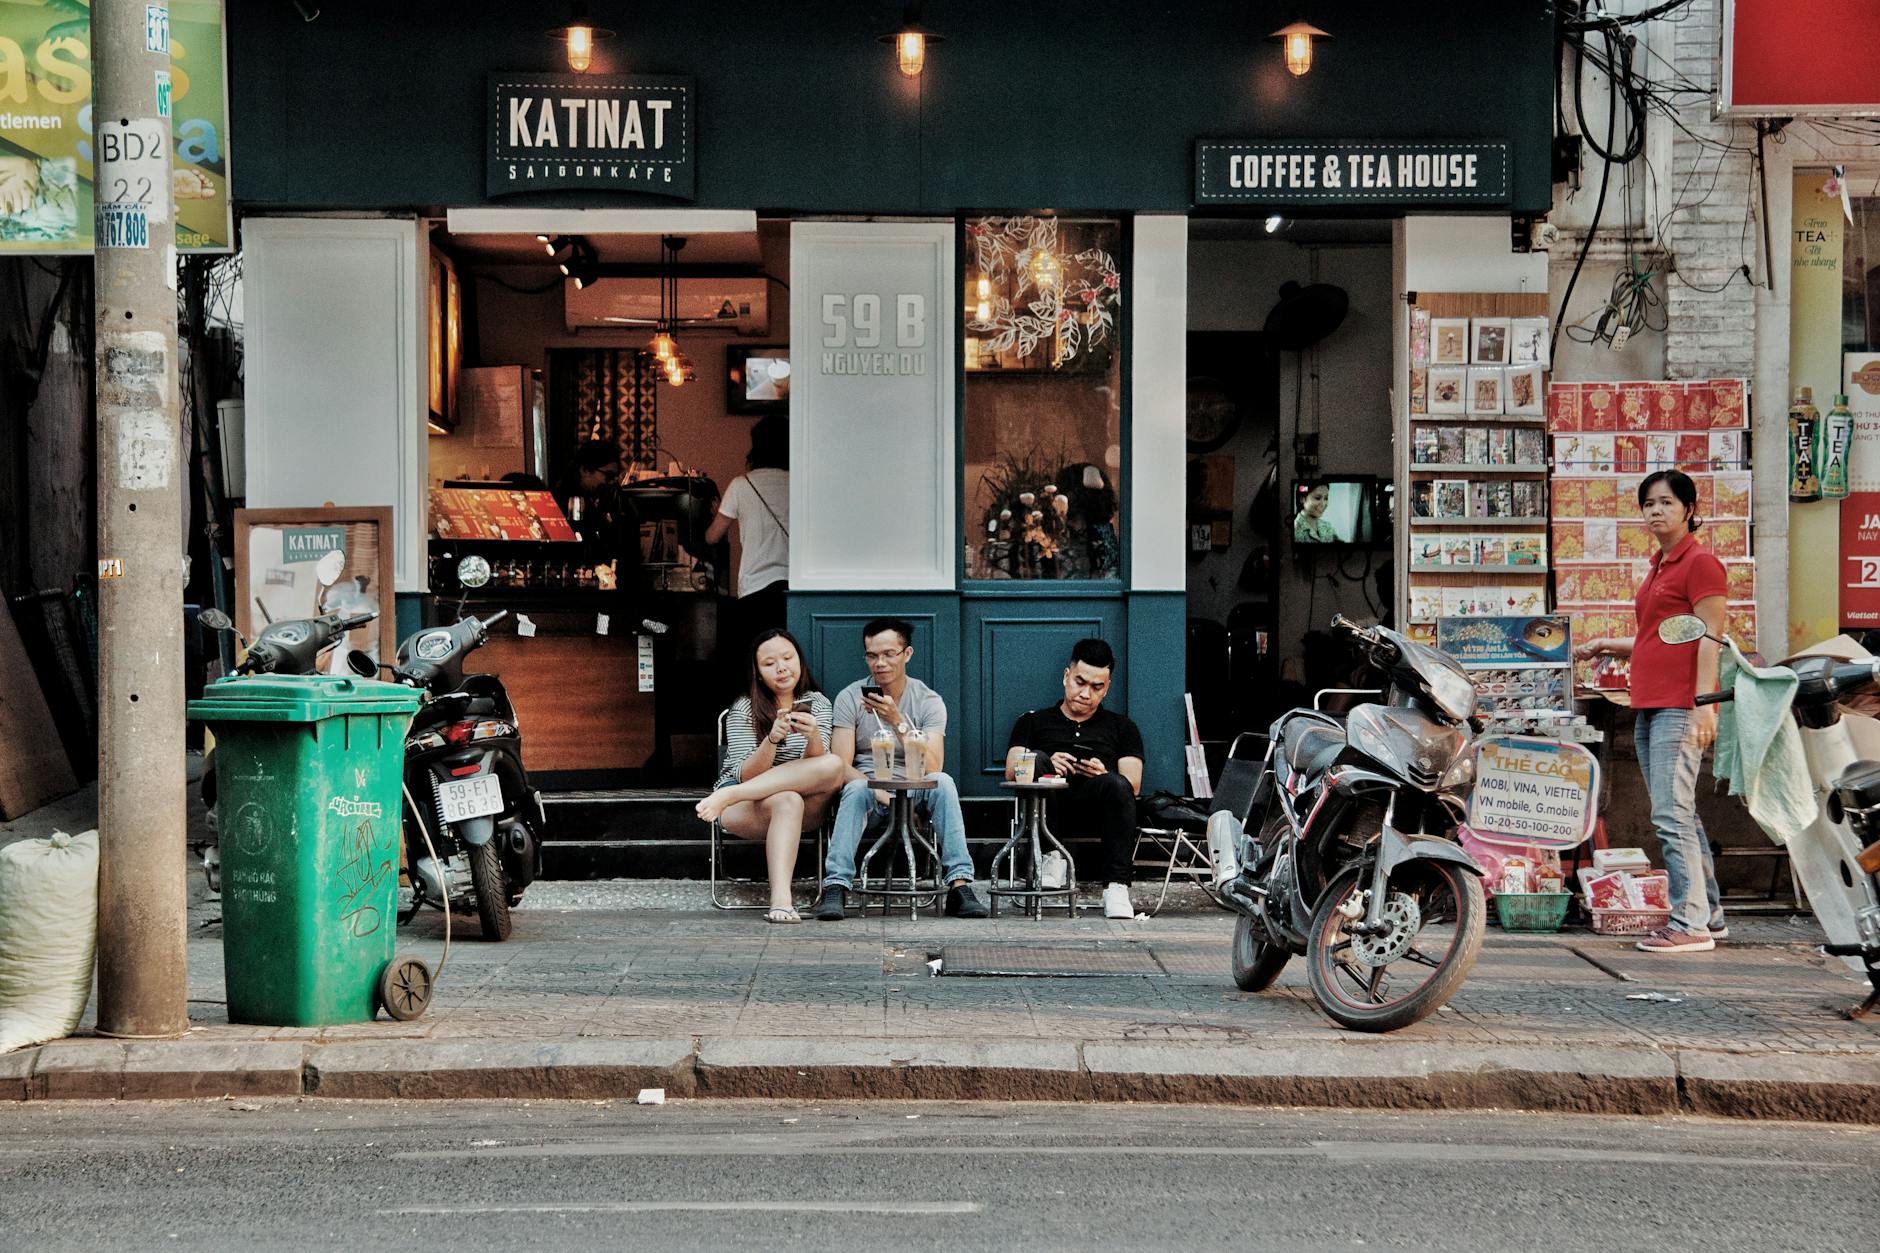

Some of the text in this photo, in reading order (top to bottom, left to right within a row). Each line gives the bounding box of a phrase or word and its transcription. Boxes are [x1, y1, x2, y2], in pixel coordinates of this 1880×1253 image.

[509, 97, 672, 149] KATINAT
[103, 132, 162, 162] BD2
[1229, 154, 1477, 188] COFFEE & TEA HOUSE
[822, 293, 925, 348] 59 B
[289, 534, 338, 550] KATINAT
[1857, 531, 1879, 541] NAY
[1863, 561, 1878, 582] 2
[1496, 752, 1531, 772] THẺ
[1481, 777, 1582, 800] MOBI, VINA, VIETTEL
[1479, 796, 1580, 818] VN mobile, G.mobile
[1483, 815, 1572, 835] 10-20-50-100-200
